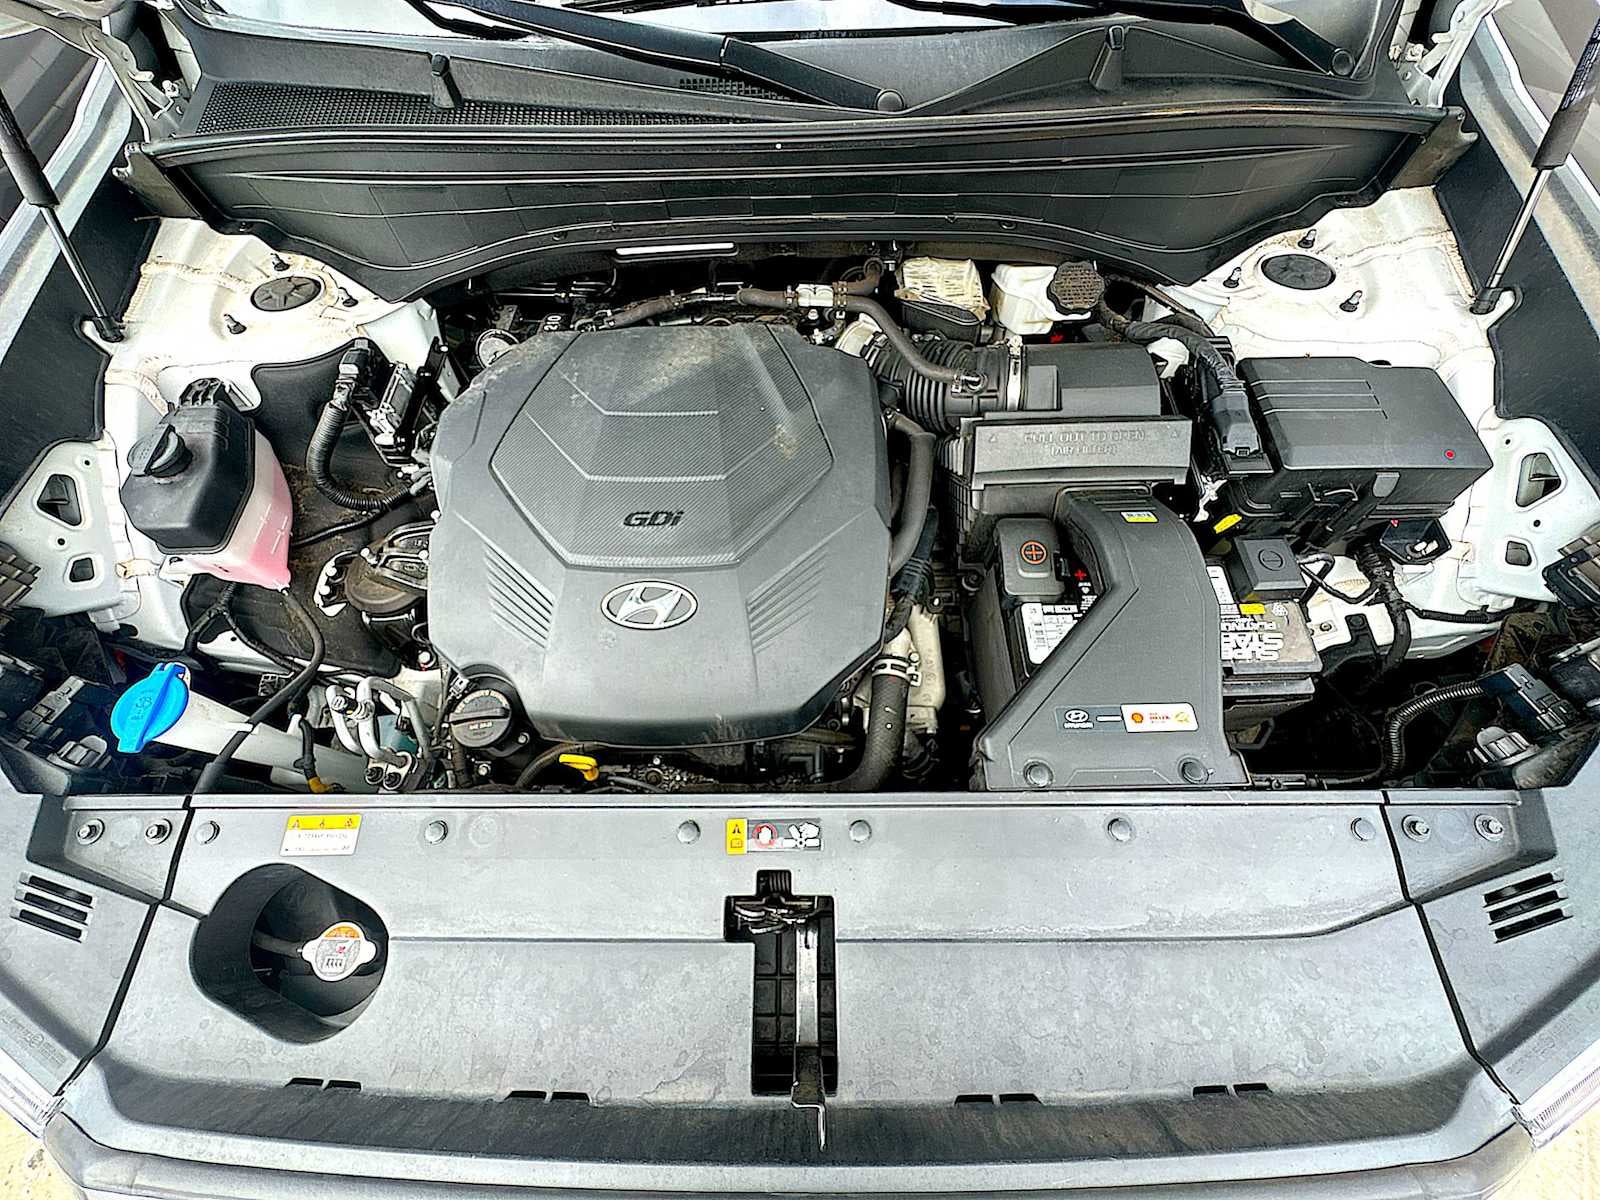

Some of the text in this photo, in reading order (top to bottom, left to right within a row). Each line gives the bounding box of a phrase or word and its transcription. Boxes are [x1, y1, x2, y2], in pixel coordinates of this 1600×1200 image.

[1059, 429, 1087, 442] OUT
[1090, 430, 1108, 441] TO
[1110, 427, 1145, 441] OPEN
[623, 511, 685, 527] GDi
[1221, 621, 1277, 632] PLATINU
[1221, 648, 1280, 660] SUPE
